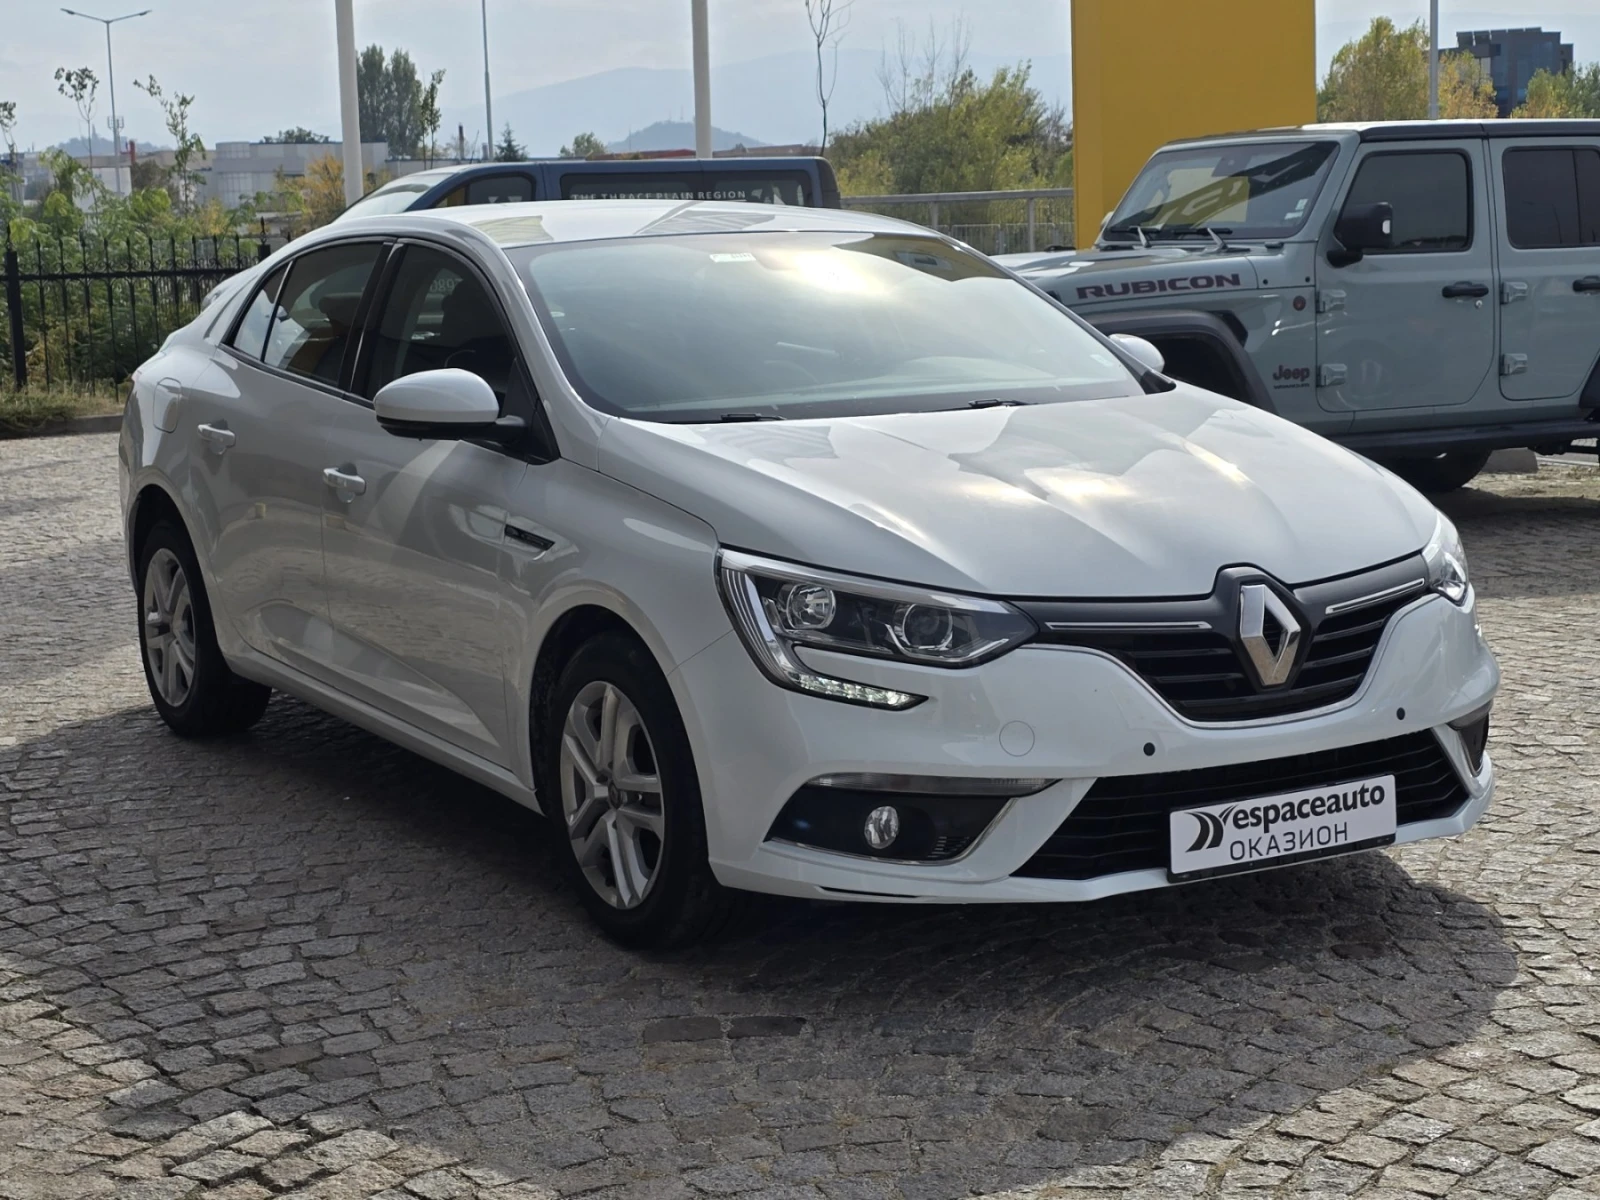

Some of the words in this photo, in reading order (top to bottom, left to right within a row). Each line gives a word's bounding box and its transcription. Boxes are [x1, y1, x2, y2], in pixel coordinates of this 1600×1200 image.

[656, 192, 694, 200] PLAIN
[698, 190, 746, 199] REGION
[1076, 273, 1241, 299] RUBICON
[1272, 364, 1310, 382] Jeep
[1232, 783, 1385, 834] espaceauto
[1229, 822, 1348, 861] ОКАЗИОН
